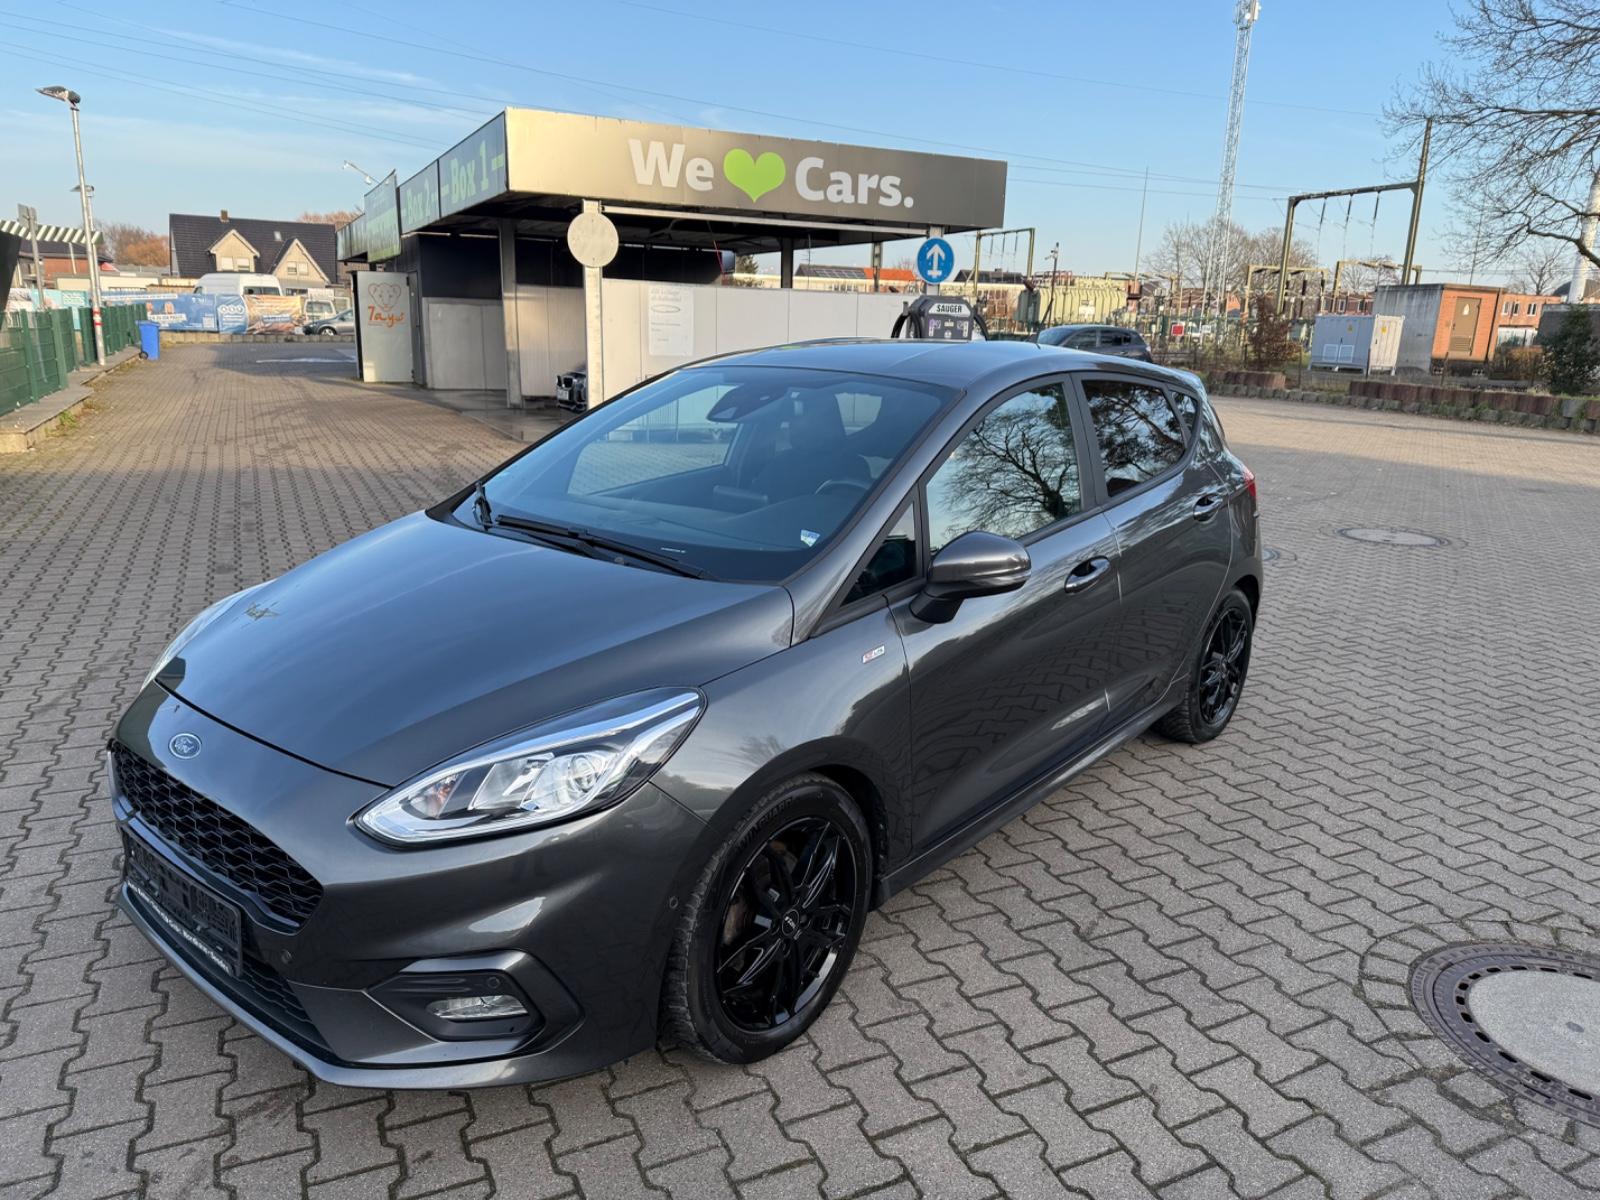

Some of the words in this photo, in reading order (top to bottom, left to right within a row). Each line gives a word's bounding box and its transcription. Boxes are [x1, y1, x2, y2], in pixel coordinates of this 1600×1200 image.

[628, 138, 714, 191] We
[795, 156, 914, 208] Cars.
[936, 304, 962, 313] SAUGER
